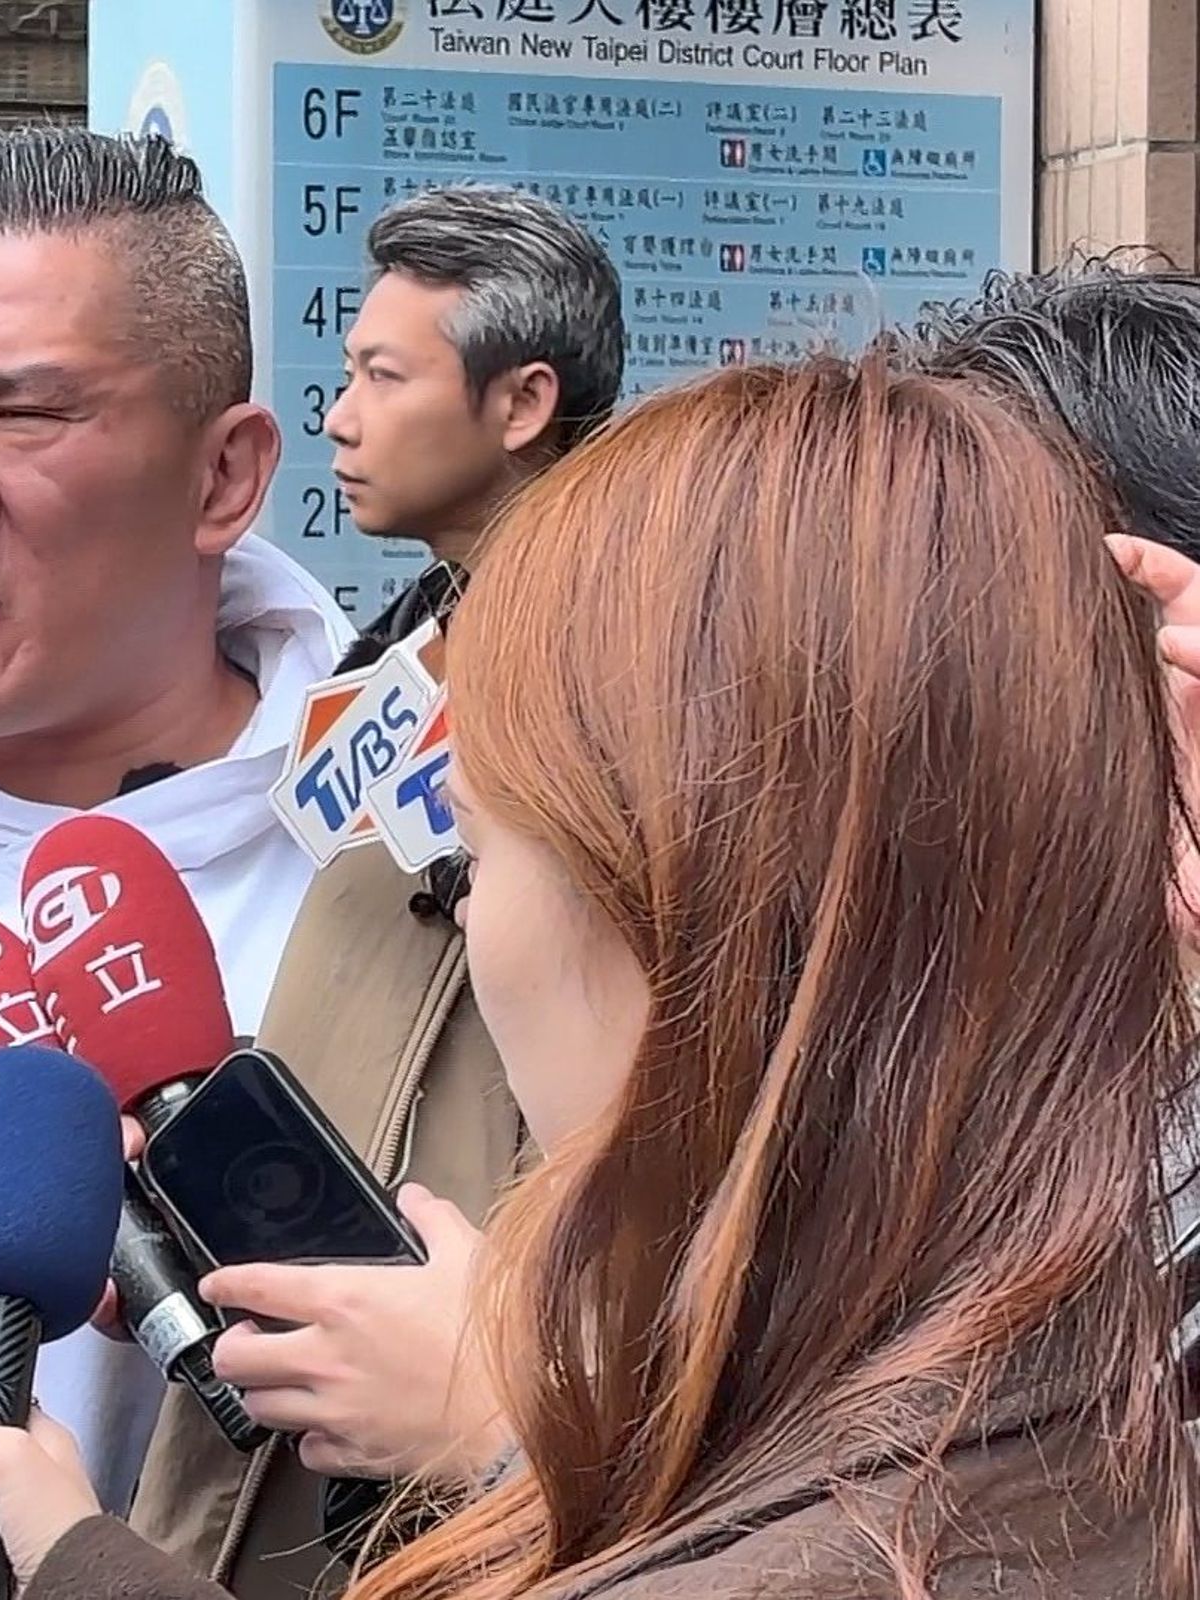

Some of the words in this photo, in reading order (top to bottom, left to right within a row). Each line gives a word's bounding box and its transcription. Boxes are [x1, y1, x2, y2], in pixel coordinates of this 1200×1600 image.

[429, 27, 511, 56] Taiwan
[521, 33, 573, 59] New
[582, 36, 648, 66] Taipei
[658, 39, 734, 67] District
[743, 44, 802, 70] Court
[814, 47, 872, 74] Floor
[879, 52, 928, 76] Plan
[303, 87, 362, 140] 6F
[303, 184, 361, 237] 5F
[302, 286, 361, 338] 4F
[294, 686, 419, 832] TVBS
